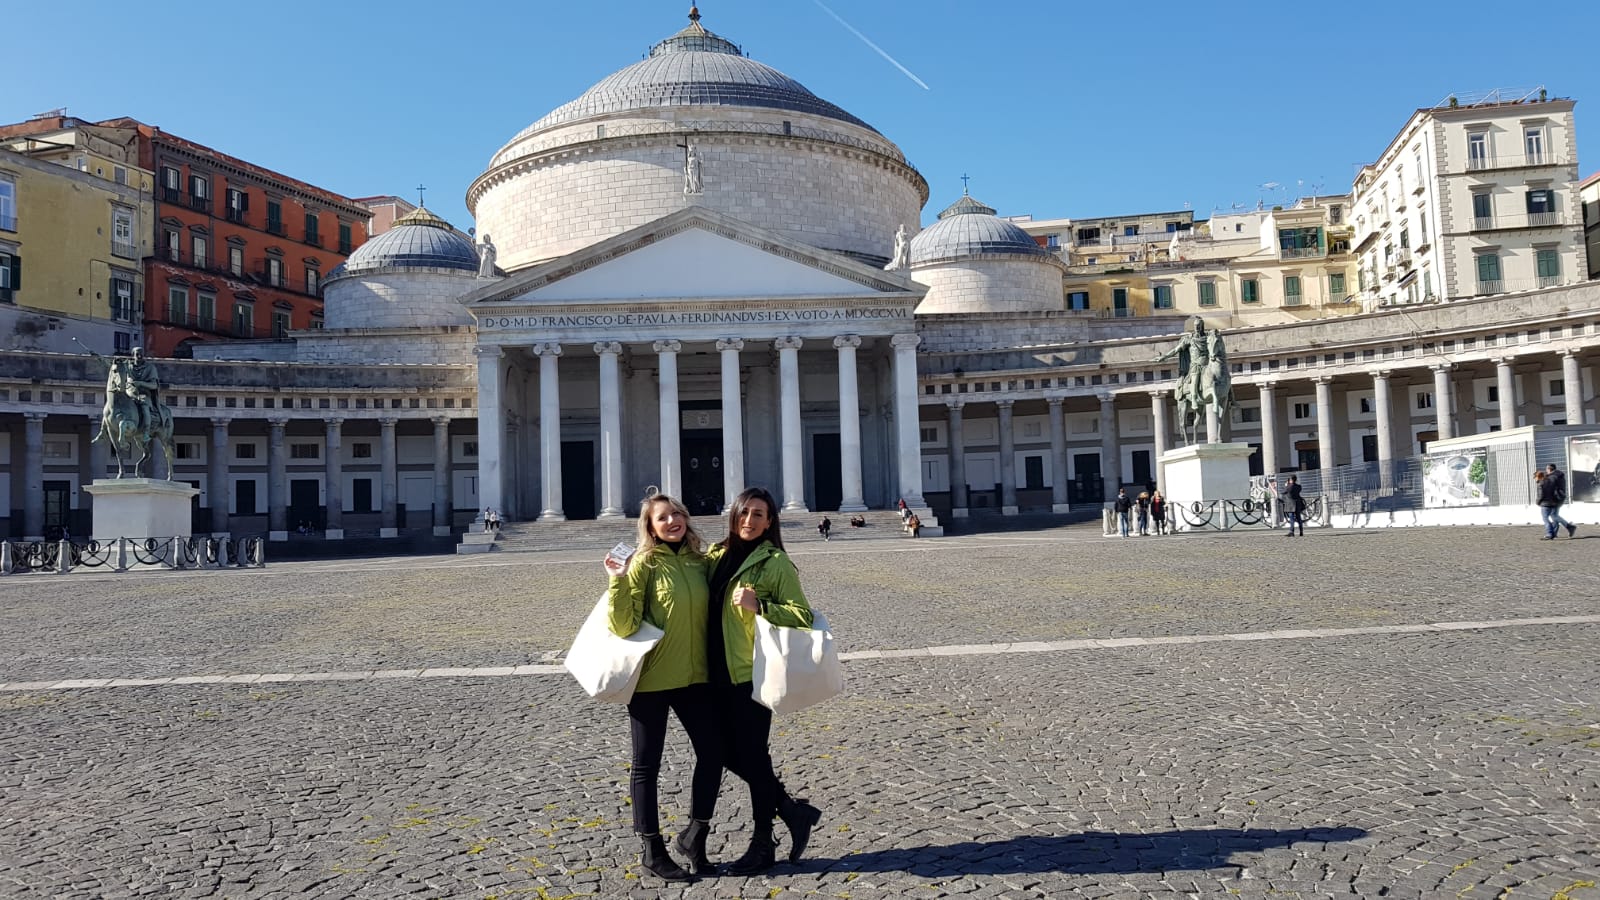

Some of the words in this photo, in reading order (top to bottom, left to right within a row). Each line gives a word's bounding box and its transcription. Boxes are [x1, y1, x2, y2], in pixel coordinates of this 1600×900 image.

[542, 315, 613, 327] FRANCISCO
[617, 314, 633, 325] DE
[681, 311, 765, 323] FERDINANDVS
[775, 310, 790, 321] EX
[795, 309, 829, 320] VOTO
[845, 308, 907, 319] MDCCCXVI
